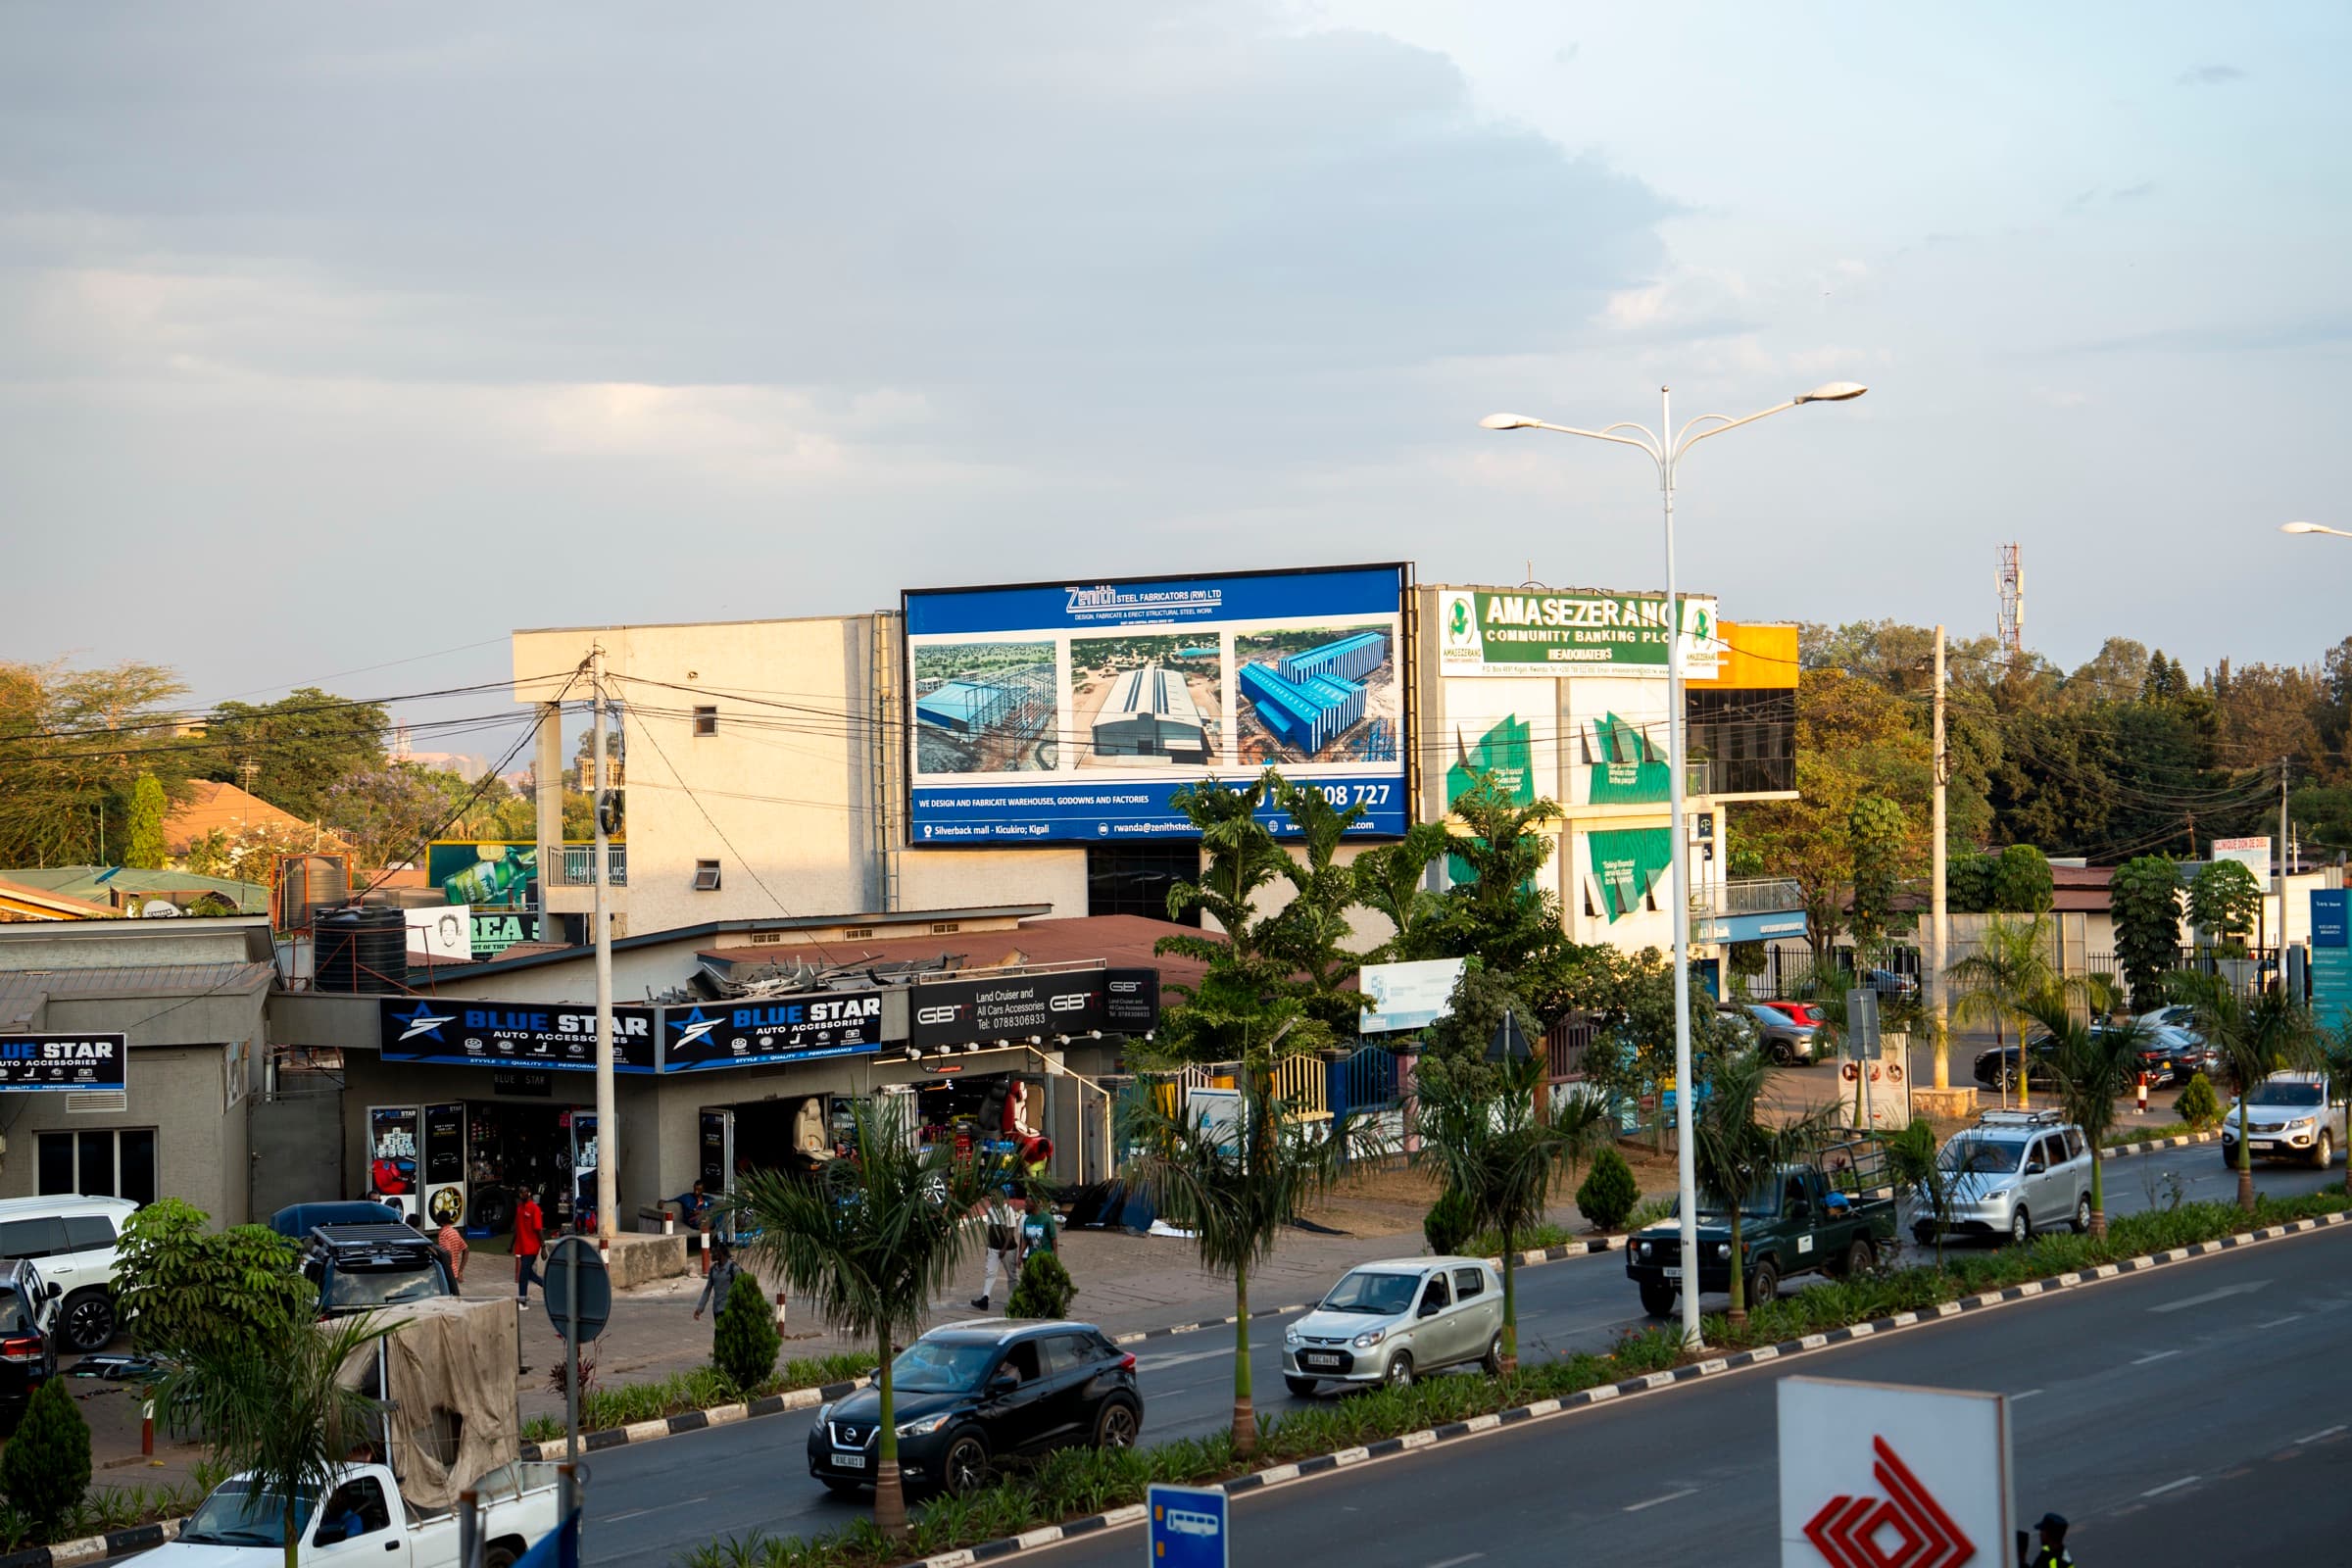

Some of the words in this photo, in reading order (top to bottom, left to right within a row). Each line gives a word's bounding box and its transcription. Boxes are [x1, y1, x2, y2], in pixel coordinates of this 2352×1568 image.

[1065, 585, 1116, 612] Zenith
[1117, 594, 1139, 604] STEEL
[1140, 591, 1189, 603] FABRICATORS
[1190, 590, 1206, 601] (RW)
[1207, 589, 1222, 599] LTD
[1146, 609, 1178, 617] STRUCTURAL
[1486, 630, 1571, 644] COMMUNITY
[1577, 630, 1636, 645] BANKING
[1642, 631, 1670, 645] PLC
[918, 800, 930, 808] WE
[931, 799, 955, 808] DESIGN
[972, 798, 1006, 807] FABRICATE
[1007, 797, 1055, 807] WAREHOUSES,
[1057, 796, 1095, 806] GODOWNS
[1096, 796, 1111, 805] AND
[1112, 795, 1150, 804] FACTORIES
[1353, 784, 1391, 806] 727
[935, 825, 972, 835] Silverback
[973, 825, 989, 834] mall
[1029, 824, 1050, 836] Kigali
[1114, 822, 1204, 833] rwanda@zenithsteel.c
[976, 991, 994, 1004] Land
[995, 990, 1019, 1003] Cruiser
[1021, 988, 1034, 1000] and
[733, 1004, 804, 1028] BLUE
[809, 997, 881, 1022] STAR
[977, 1005, 986, 1017] All
[987, 1004, 1004, 1015] Cars
[1004, 1002, 1045, 1014] Accessories
[465, 1010, 549, 1031] BLUE
[558, 1013, 649, 1037] STAR
[756, 1026, 786, 1036] AUTO
[791, 1018, 865, 1034] ACCESSORIES
[977, 1018, 991, 1031] Tel:
[994, 1013, 1046, 1030] 0788306933
[493, 1031, 529, 1040] AUTO
[535, 1033, 628, 1045] ACCESSOES
[0, 1043, 36, 1059] UE
[43, 1042, 114, 1058] STAR
[808, 1048, 853, 1056] PERFORMANCE
[494, 1073, 515, 1084] BLUE
[525, 1074, 545, 1085] STAR
